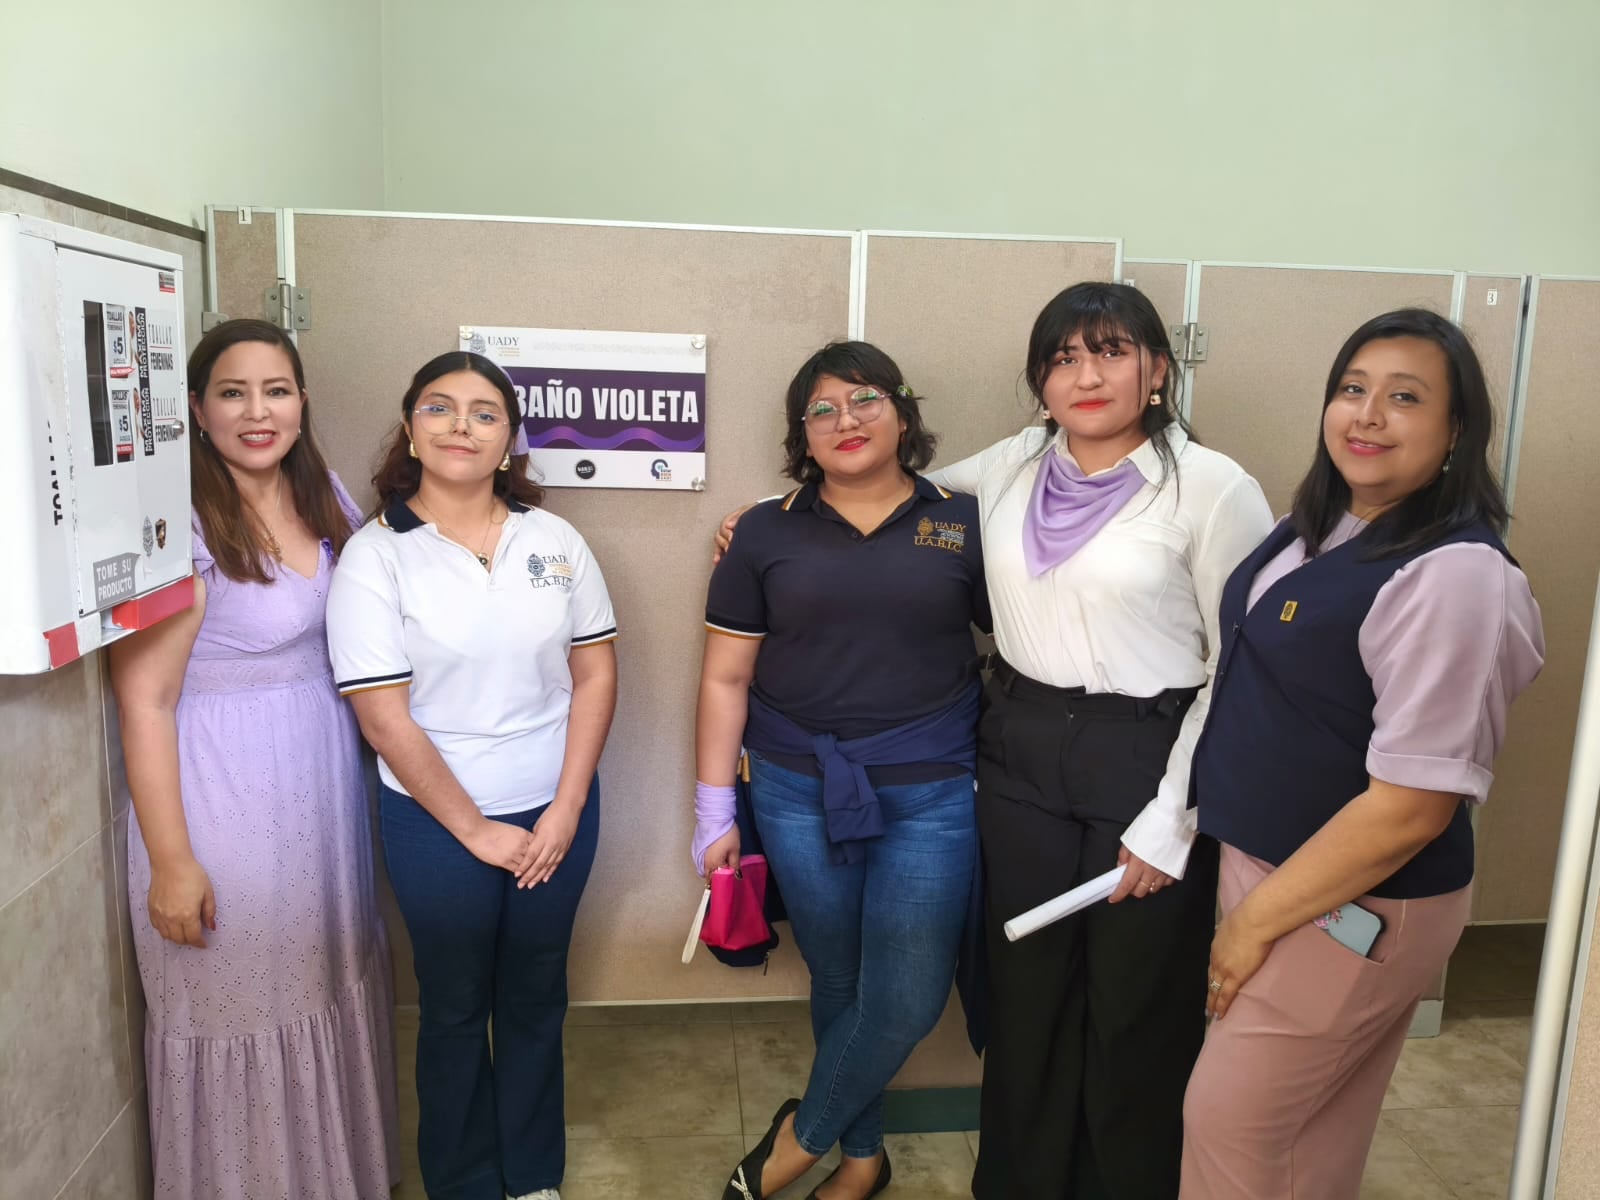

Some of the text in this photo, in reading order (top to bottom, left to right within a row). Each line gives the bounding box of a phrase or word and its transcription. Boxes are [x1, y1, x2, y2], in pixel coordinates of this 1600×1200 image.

[113, 336, 124, 354] $5
[488, 336, 519, 346] UADY
[514, 379, 699, 423] BAÑO VIOLETA
[119, 415, 129, 432] $5
[155, 424, 179, 442] FEMENINA
[935, 521, 966, 532] UADY
[542, 555, 569, 564] UAD
[96, 558, 132, 581] TOME SU
[98, 576, 132, 601] PRODUCTO
